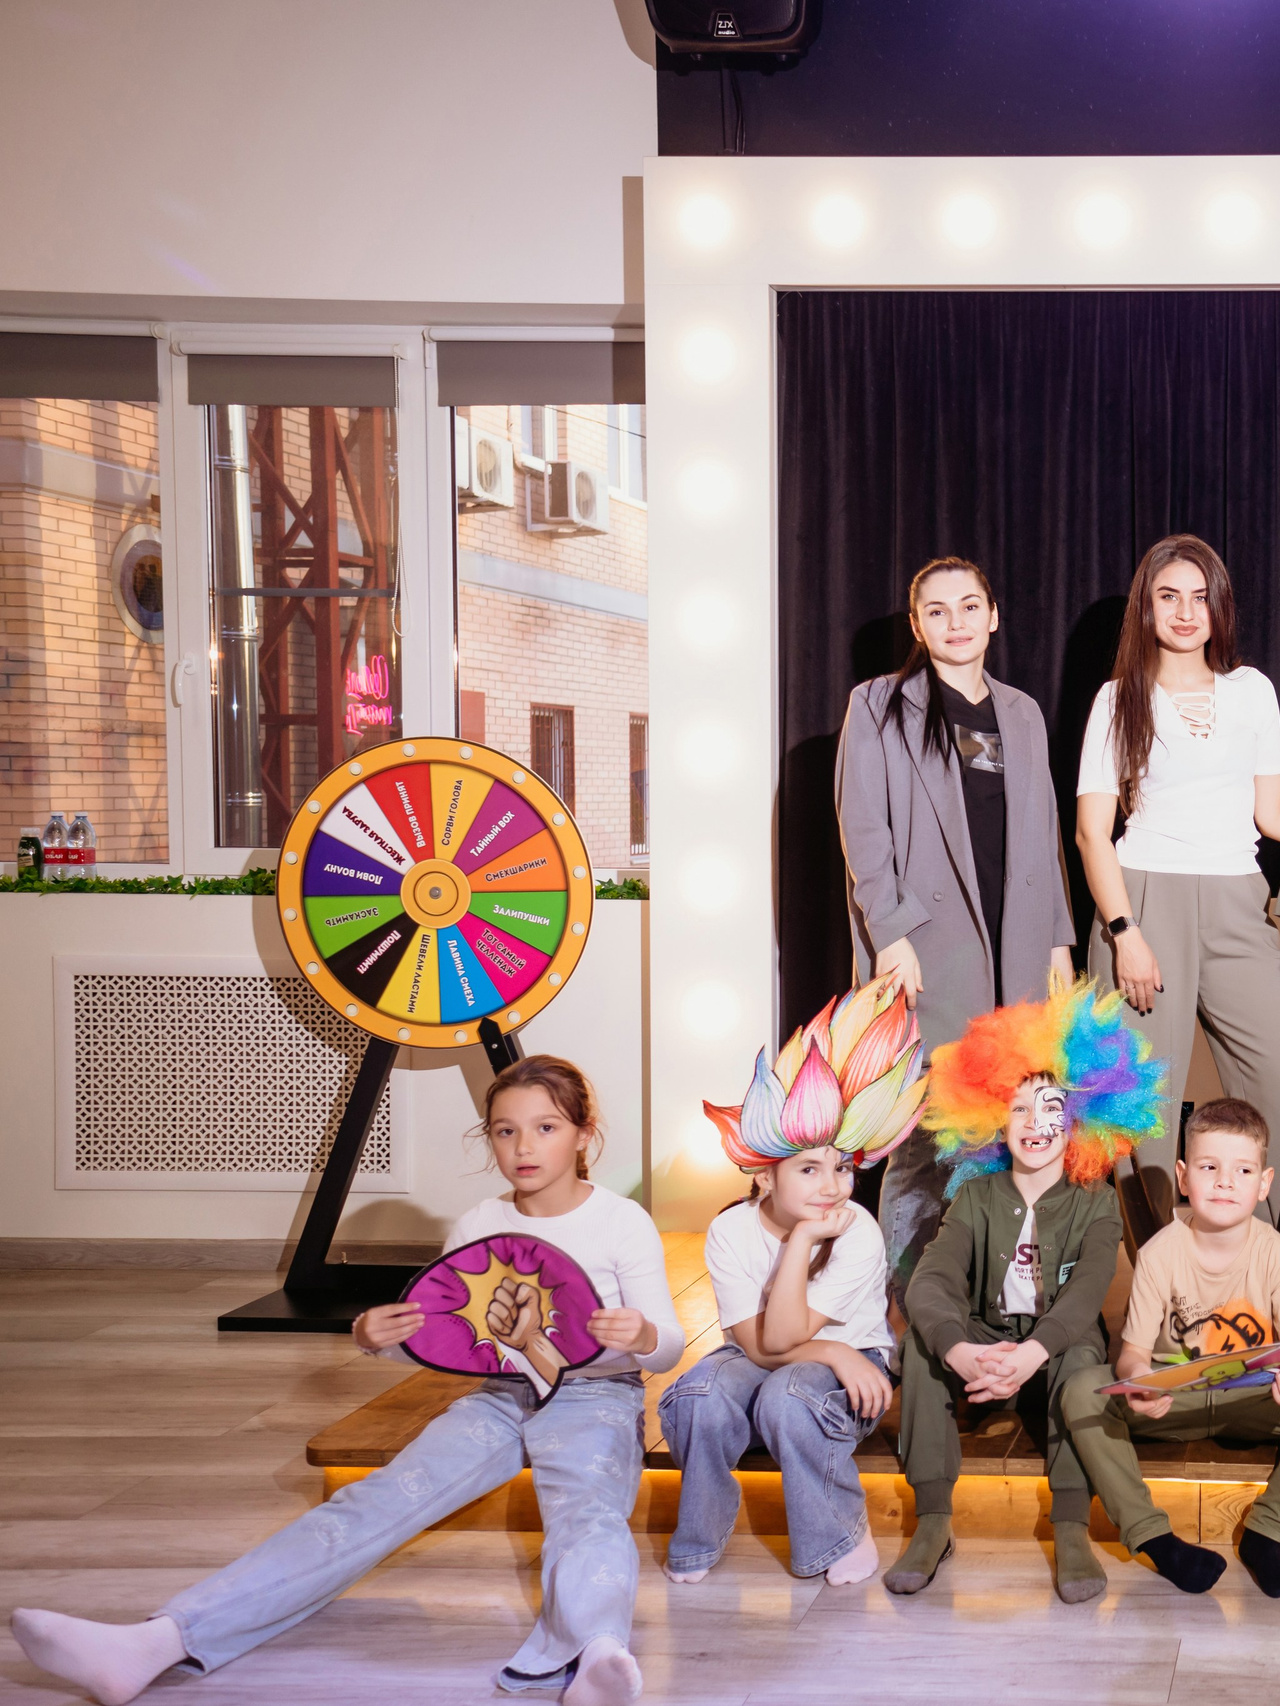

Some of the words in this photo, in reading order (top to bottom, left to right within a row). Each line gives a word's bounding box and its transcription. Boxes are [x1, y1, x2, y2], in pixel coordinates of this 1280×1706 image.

[395, 781, 415, 816] ПРИНЯТ
[441, 815, 455, 846] СОРВИ
[449, 779, 463, 814] ГОЛОВА
[341, 806, 371, 834] ЗАРУБА
[408, 815, 426, 848] ВЫЗОВ
[368, 830, 406, 865] ЖЕСТКАЯ
[469, 824, 501, 857] ТАЙНЫЙ
[324, 863, 355, 877] ВОЛНУ
[356, 871, 383, 885] ЛОВИ
[485, 858, 548, 882] СМЕХШАРИКИ
[325, 907, 379, 927] ЗАСКАМИТЬ
[493, 904, 550, 926] ЗАЛИПУШКИ
[416, 934, 431, 971] ШЕВЕЛИ
[476, 939, 516, 978] ЧЕЛЛЕНДЖ
[482, 928, 498, 946] ТОТ
[496, 942, 527, 970] САМЫЙ
[447, 939, 465, 976] ЛАВИНА
[460, 977, 475, 1006] СМЕХА
[407, 972, 422, 1013] ЛАСТАМИ
